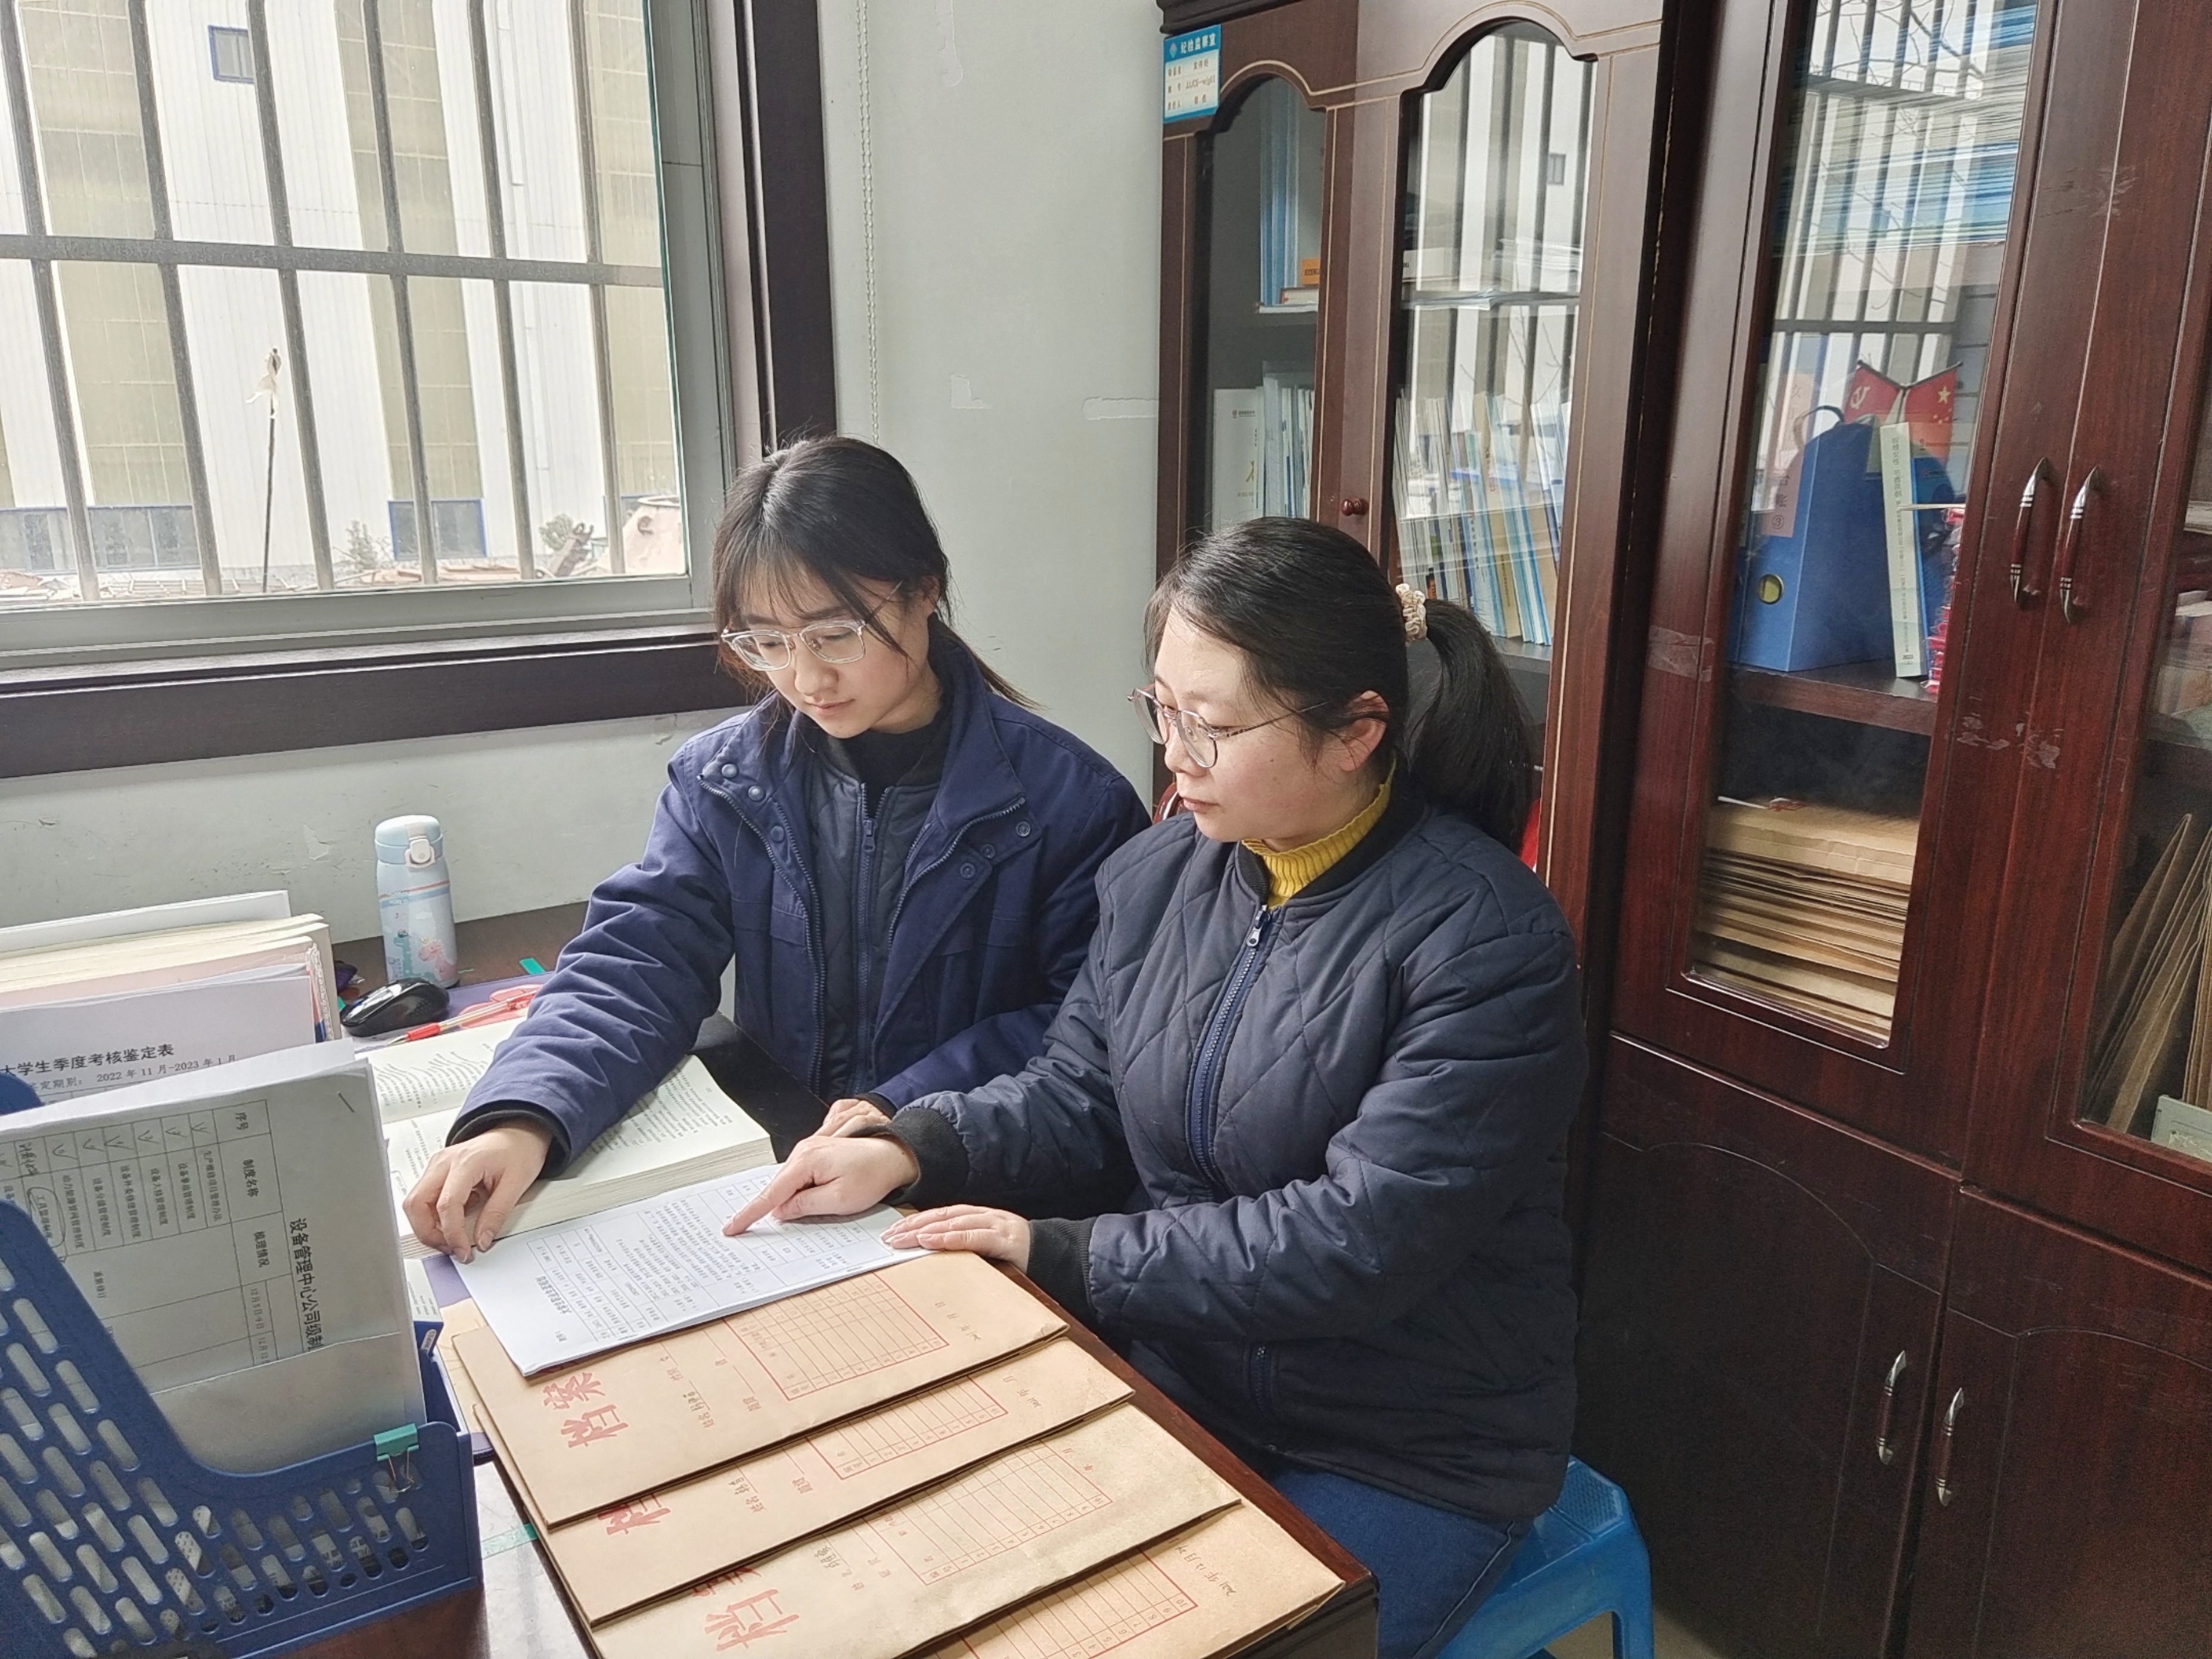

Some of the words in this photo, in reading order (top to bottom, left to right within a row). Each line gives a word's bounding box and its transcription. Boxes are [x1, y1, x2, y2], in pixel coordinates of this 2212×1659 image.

[0, 1043, 174, 1077] 大学生季度考核鉴定表
[235, 1111, 249, 1131] 序号
[242, 1158, 259, 1198] 制度名称
[543, 1372, 628, 1448] 档案
